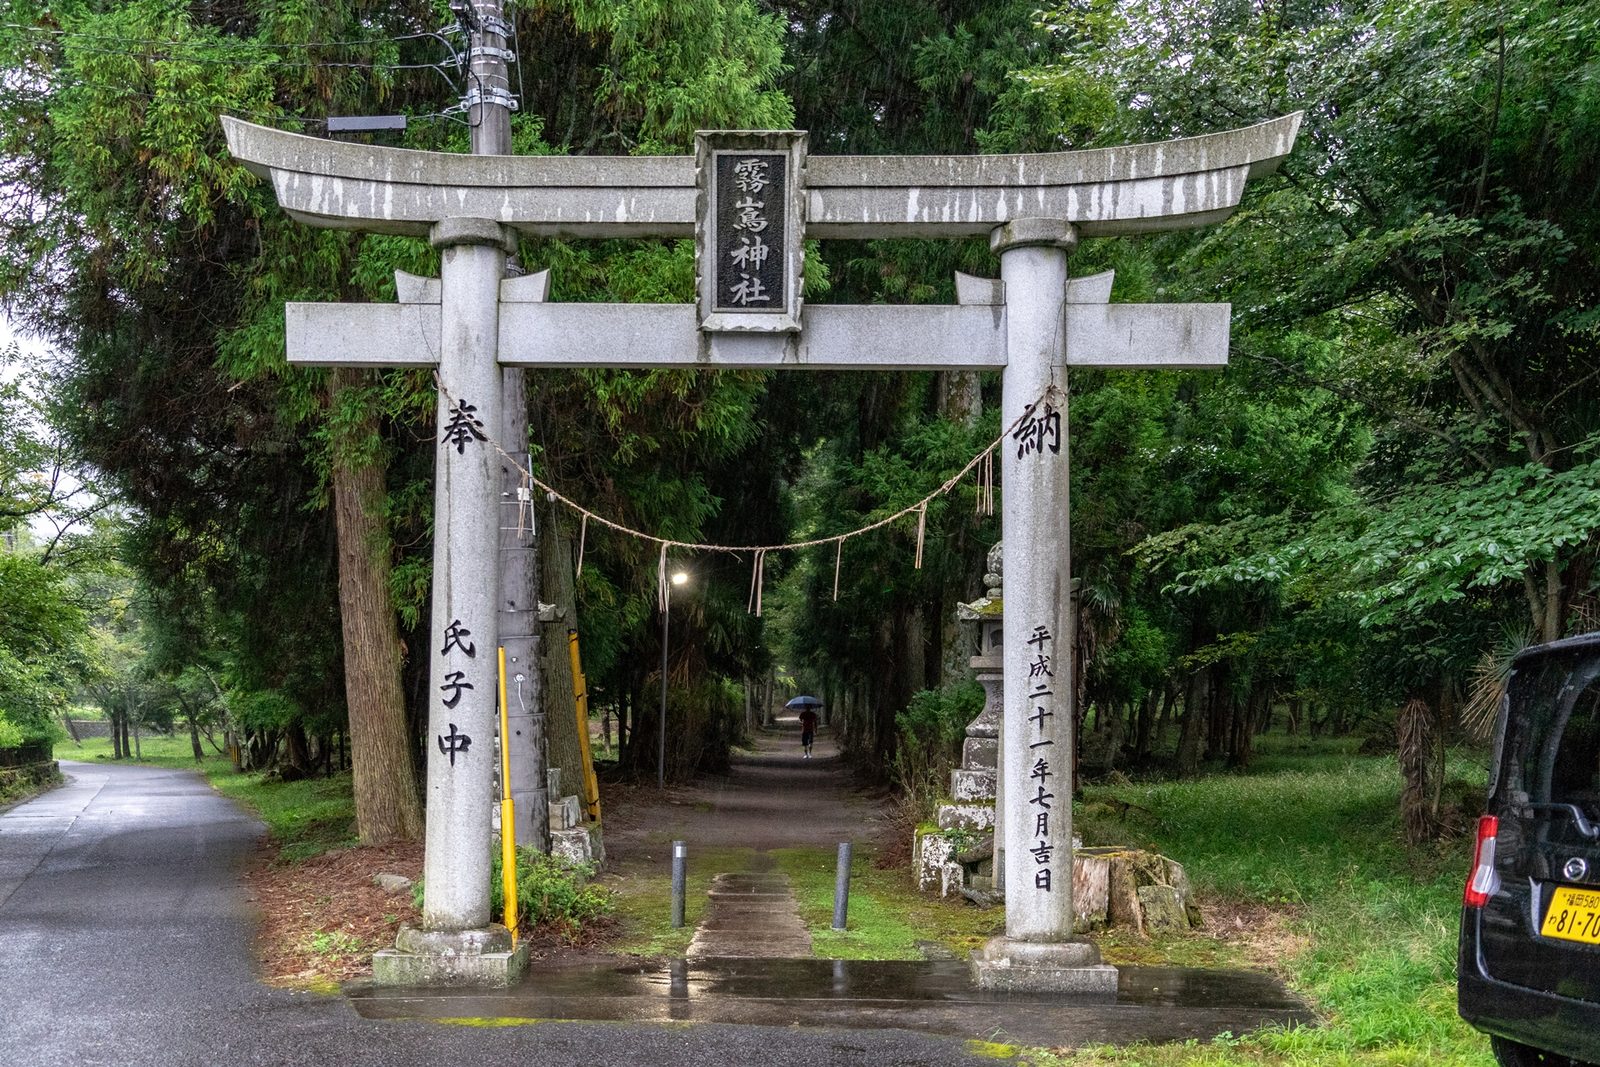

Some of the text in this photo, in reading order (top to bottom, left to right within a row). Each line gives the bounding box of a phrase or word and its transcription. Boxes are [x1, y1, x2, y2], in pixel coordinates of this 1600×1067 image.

[441, 399, 488, 455] 奉
[1013, 402, 1061, 460] 納
[438, 619, 476, 766] 氏子中
[1027, 625, 1055, 893] 平成二十一年七月吉日
